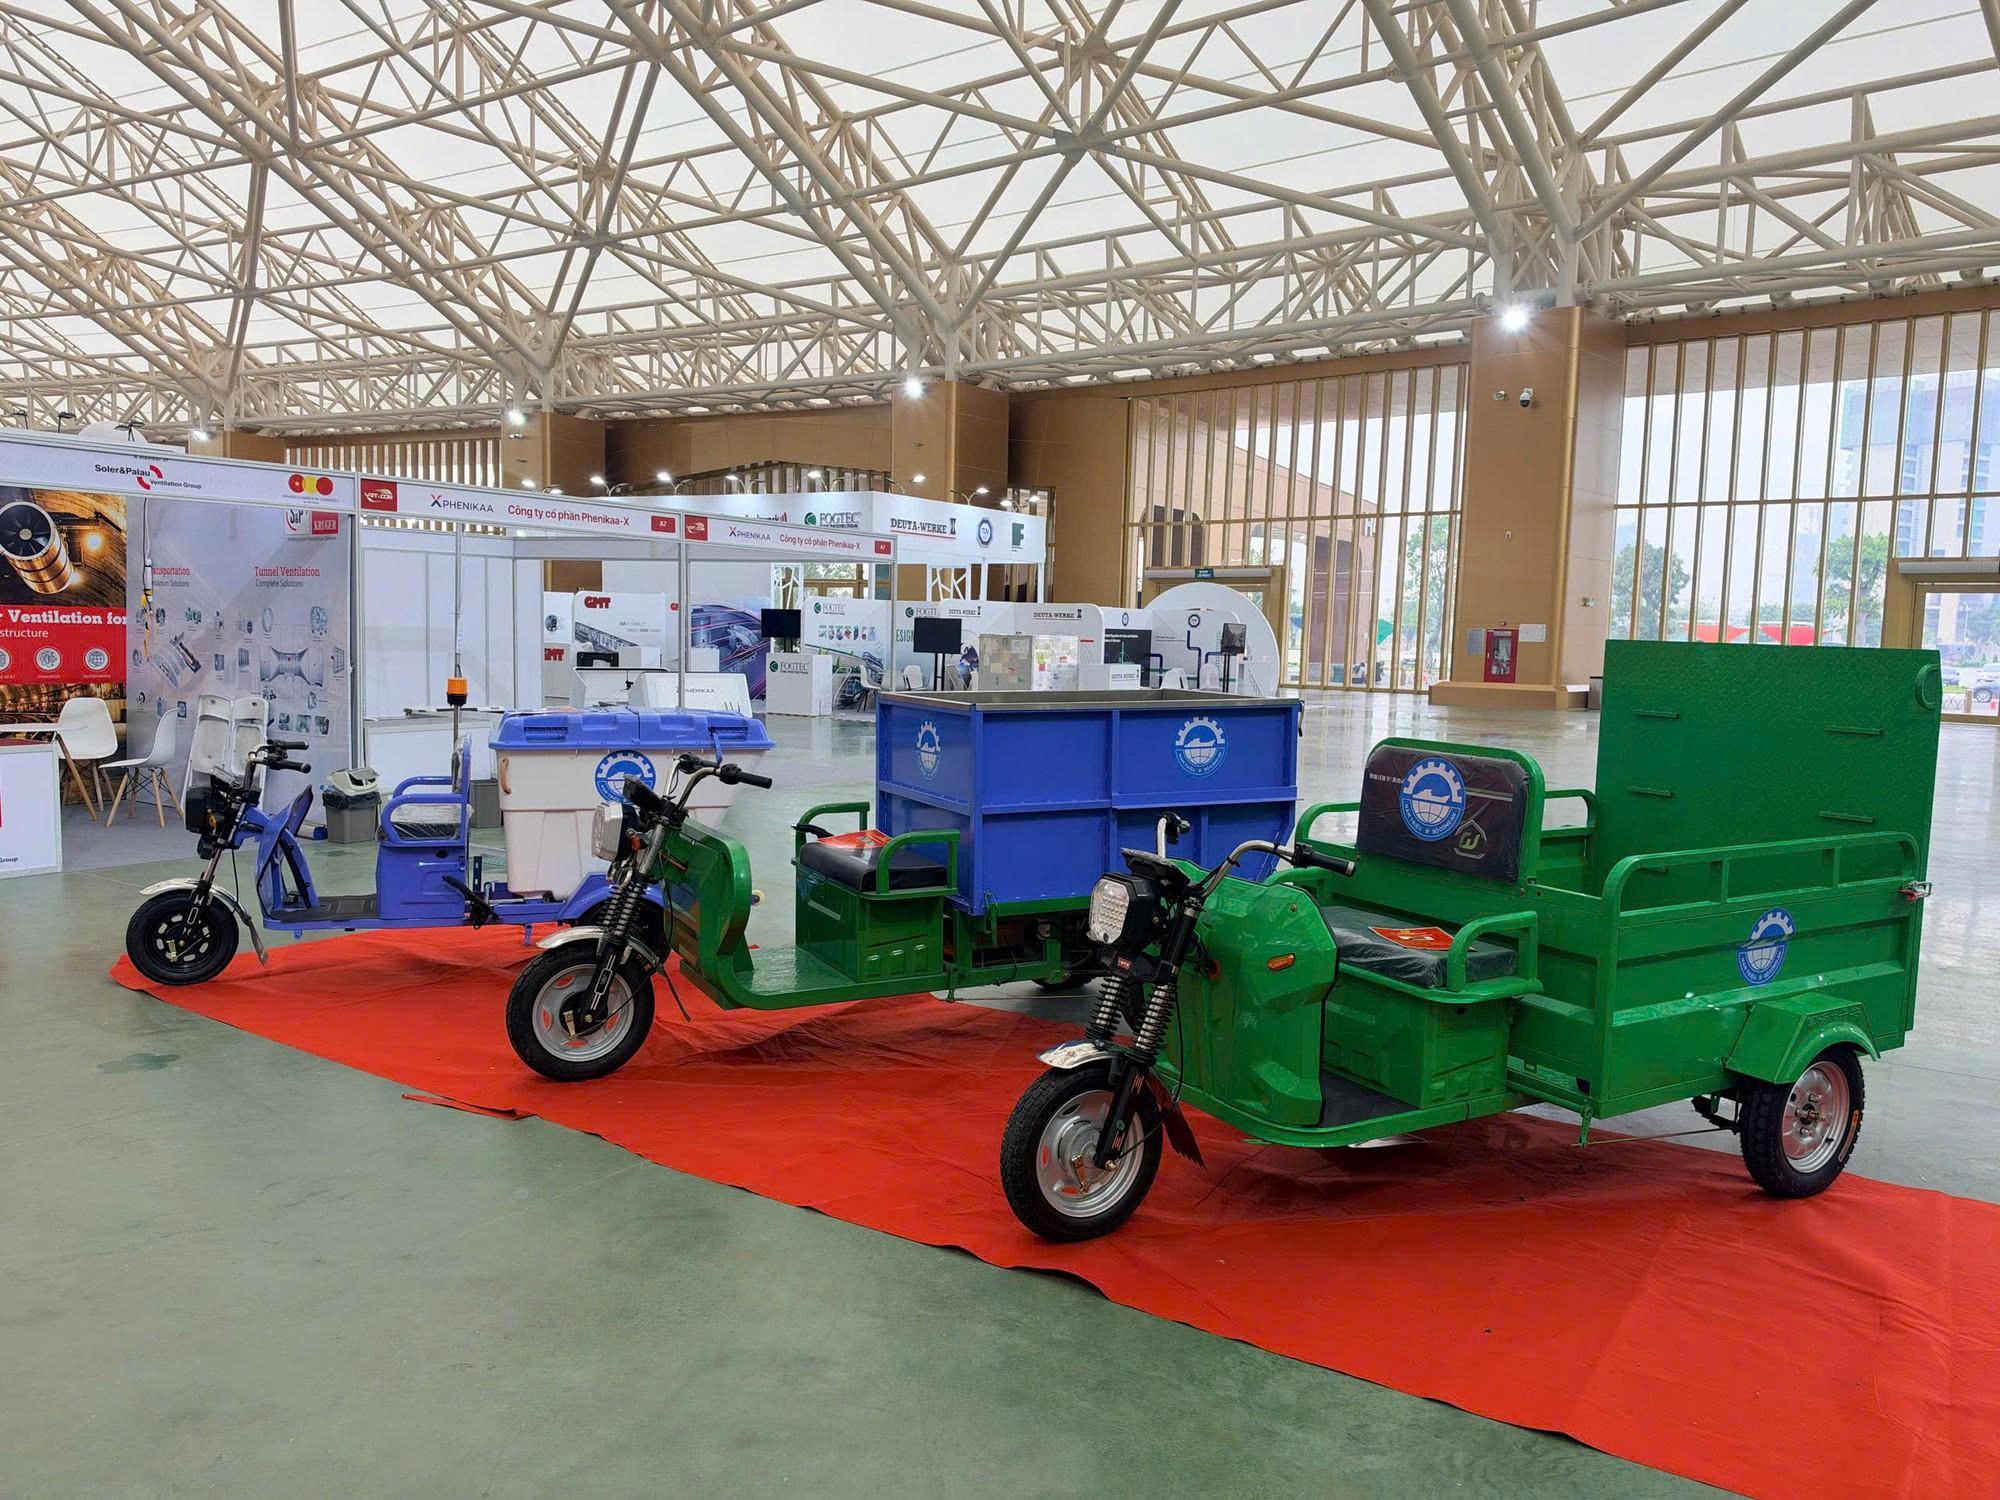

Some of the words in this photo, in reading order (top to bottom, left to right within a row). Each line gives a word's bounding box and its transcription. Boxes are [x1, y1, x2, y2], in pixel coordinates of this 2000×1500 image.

[95, 464, 151, 477] Soler&Palau
[150, 479, 183, 488] Ventilation
[183, 481, 202, 490] Group
[443, 499, 494, 513] PHENIKAA
[507, 504, 533, 519] Công
[534, 508, 544, 520] ty
[581, 512, 630, 527] Phenikaa-X
[819, 511, 859, 524] FOGTEC
[659, 520, 668, 528] A7
[890, 518, 947, 534] DEUTA-WERKE
[737, 530, 771, 541] PHENIKAA
[828, 540, 861, 551] Phenikaa-X
[152, 566, 191, 577] ansportation
[254, 566, 279, 577] Tunnel
[281, 565, 321, 577] Ventilation
[255, 579, 279, 589] Complete
[279, 580, 304, 588] Solutions
[915, 607, 937, 615] FOGT
[8, 609, 103, 625] Ventilation
[895, 629, 914, 642] ESIG
[780, 661, 809, 671] FOGTEC
